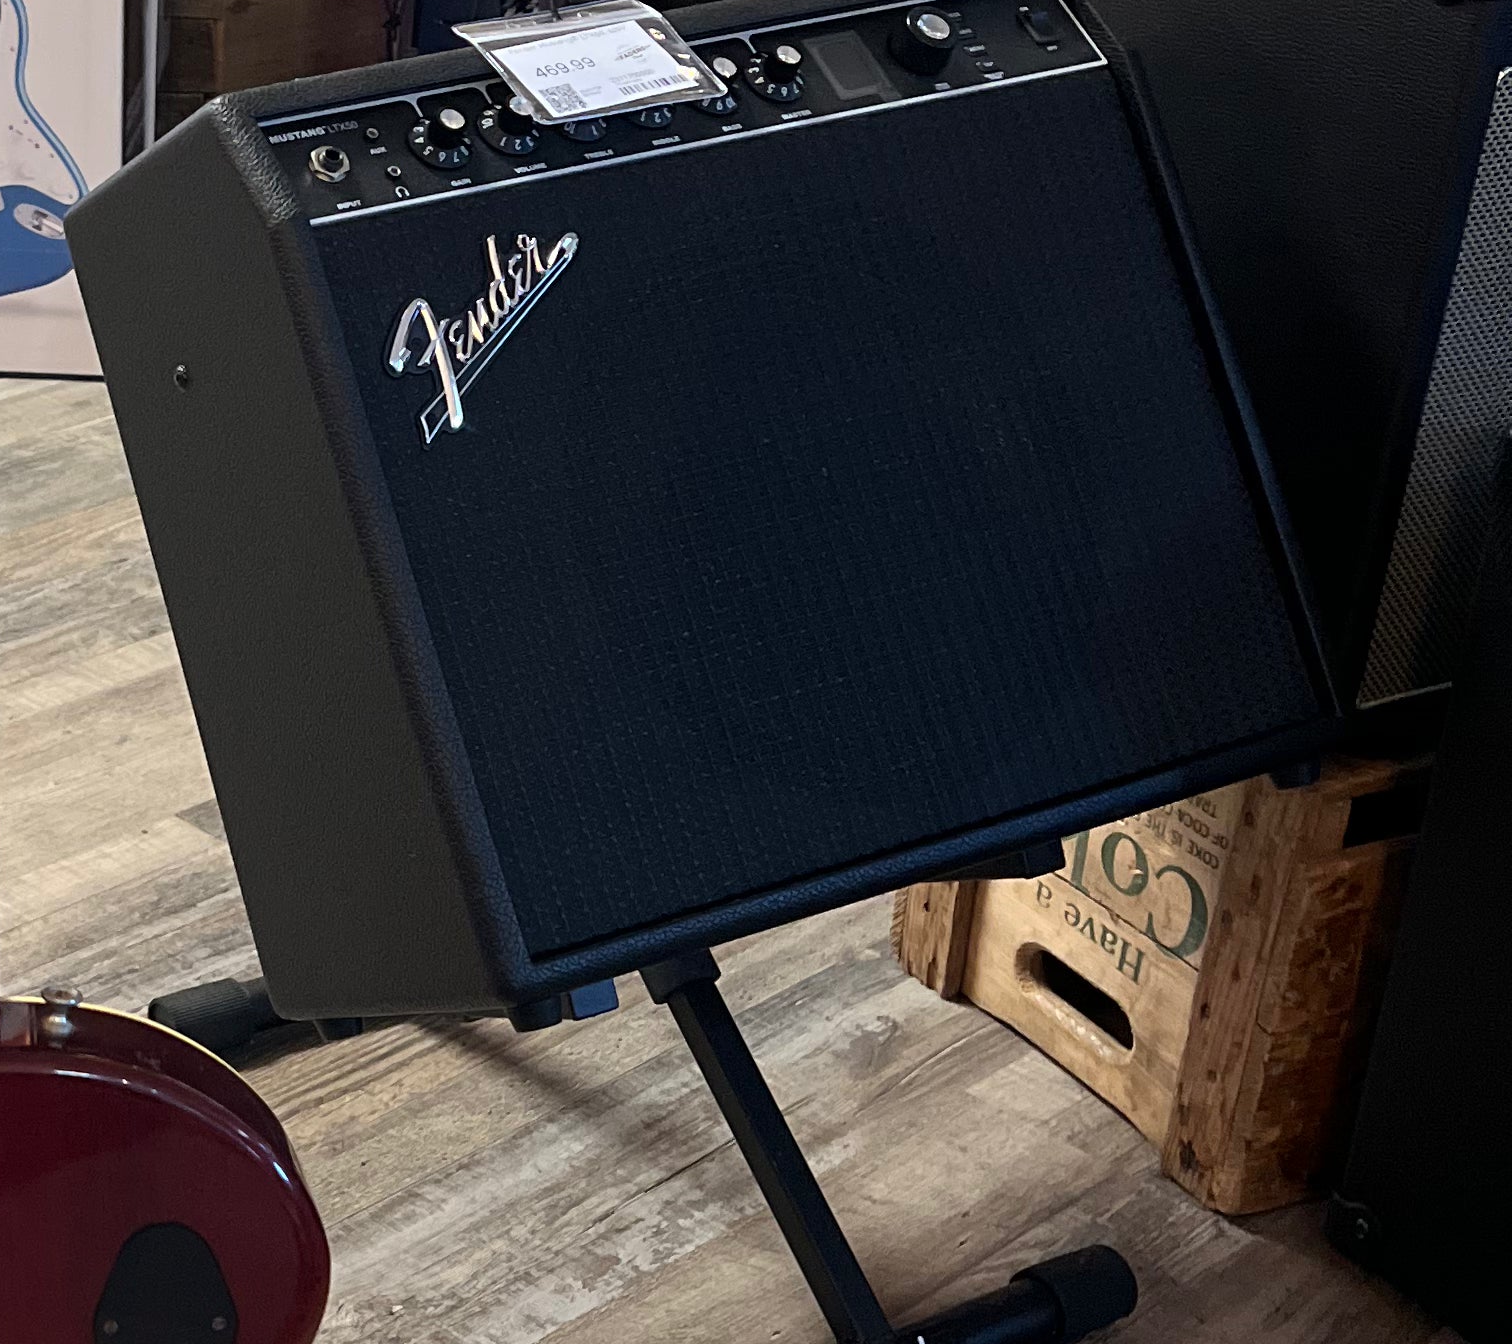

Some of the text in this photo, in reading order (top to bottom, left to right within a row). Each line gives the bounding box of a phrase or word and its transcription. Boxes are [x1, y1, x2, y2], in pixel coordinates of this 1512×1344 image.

[536, 56, 596, 80] 469.99
[388, 232, 580, 444] Fender
[1186, 839, 1220, 869] COKE
[1036, 880, 1146, 986] Have a
